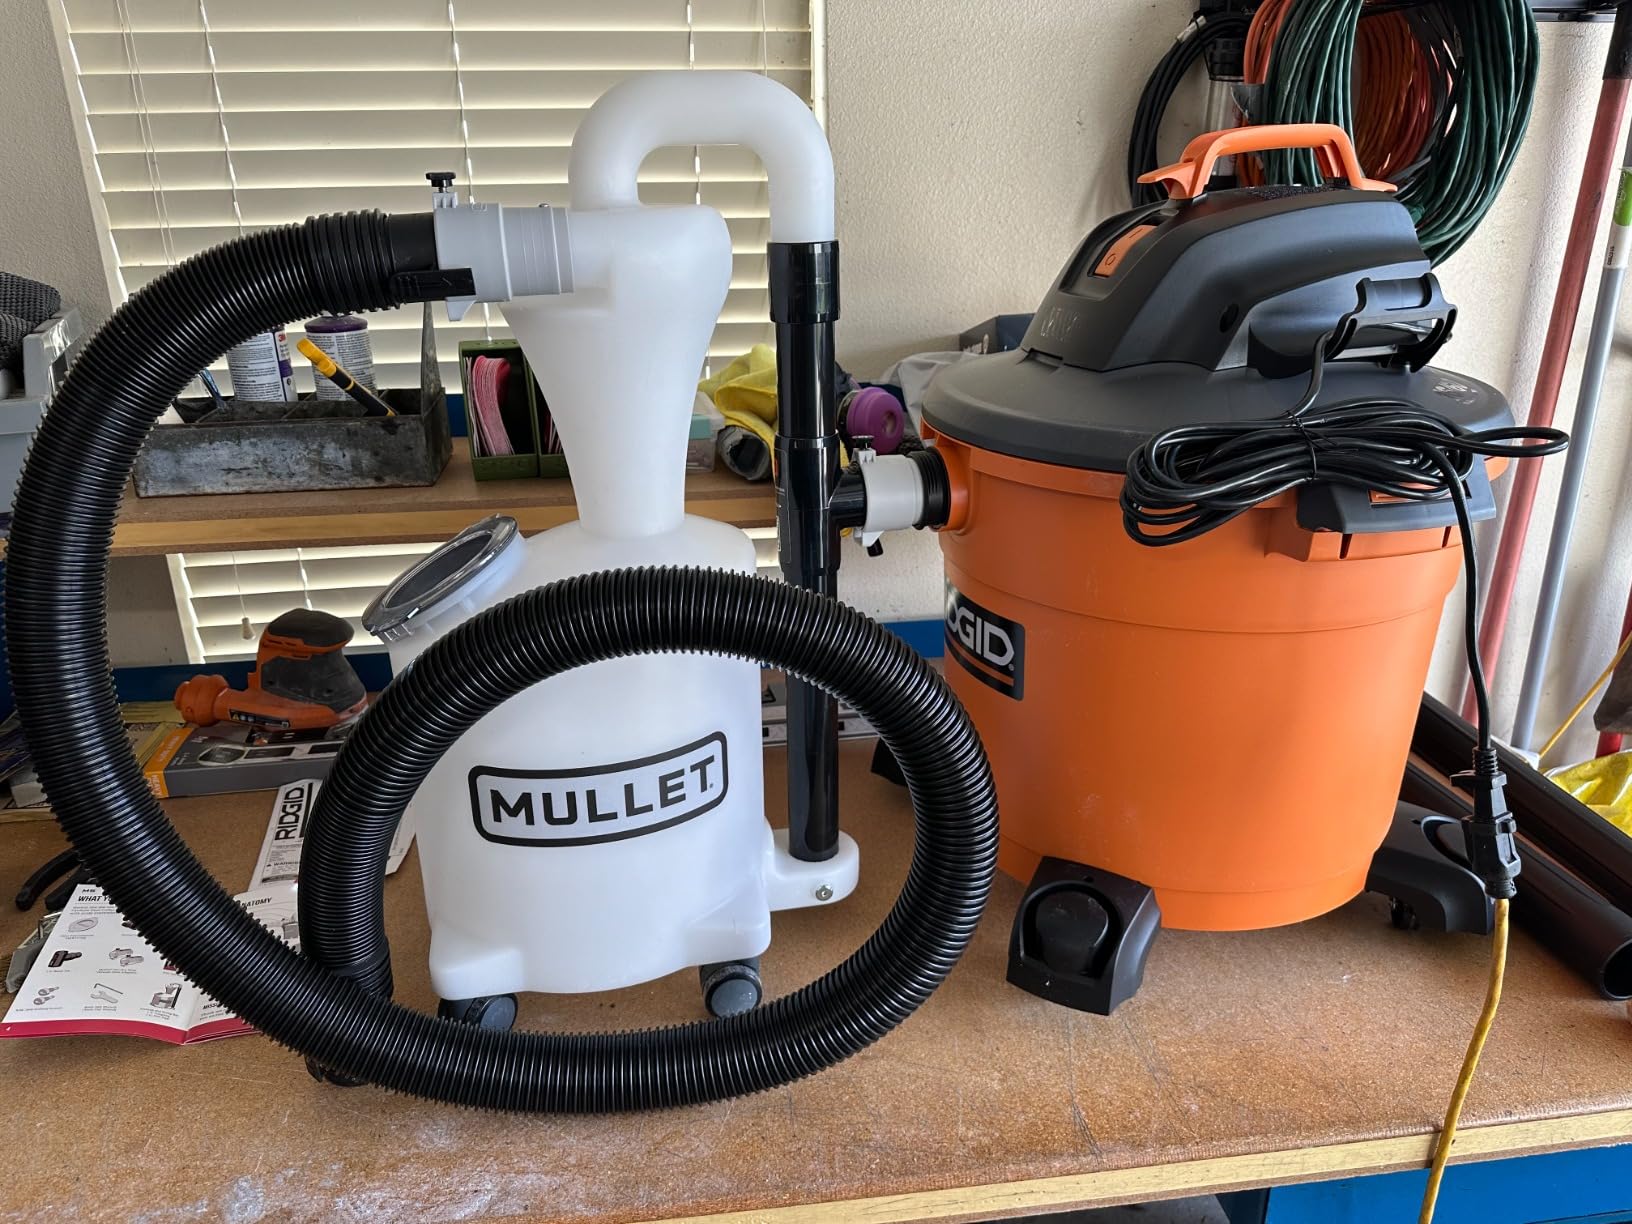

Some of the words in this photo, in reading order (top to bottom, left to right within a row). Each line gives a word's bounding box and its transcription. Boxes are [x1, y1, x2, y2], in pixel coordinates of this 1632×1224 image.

[948, 598, 1015, 667] DGID
[274, 786, 305, 841] RIDGID
[490, 754, 715, 826] MULLET
[241, 897, 272, 907] NATOMY
